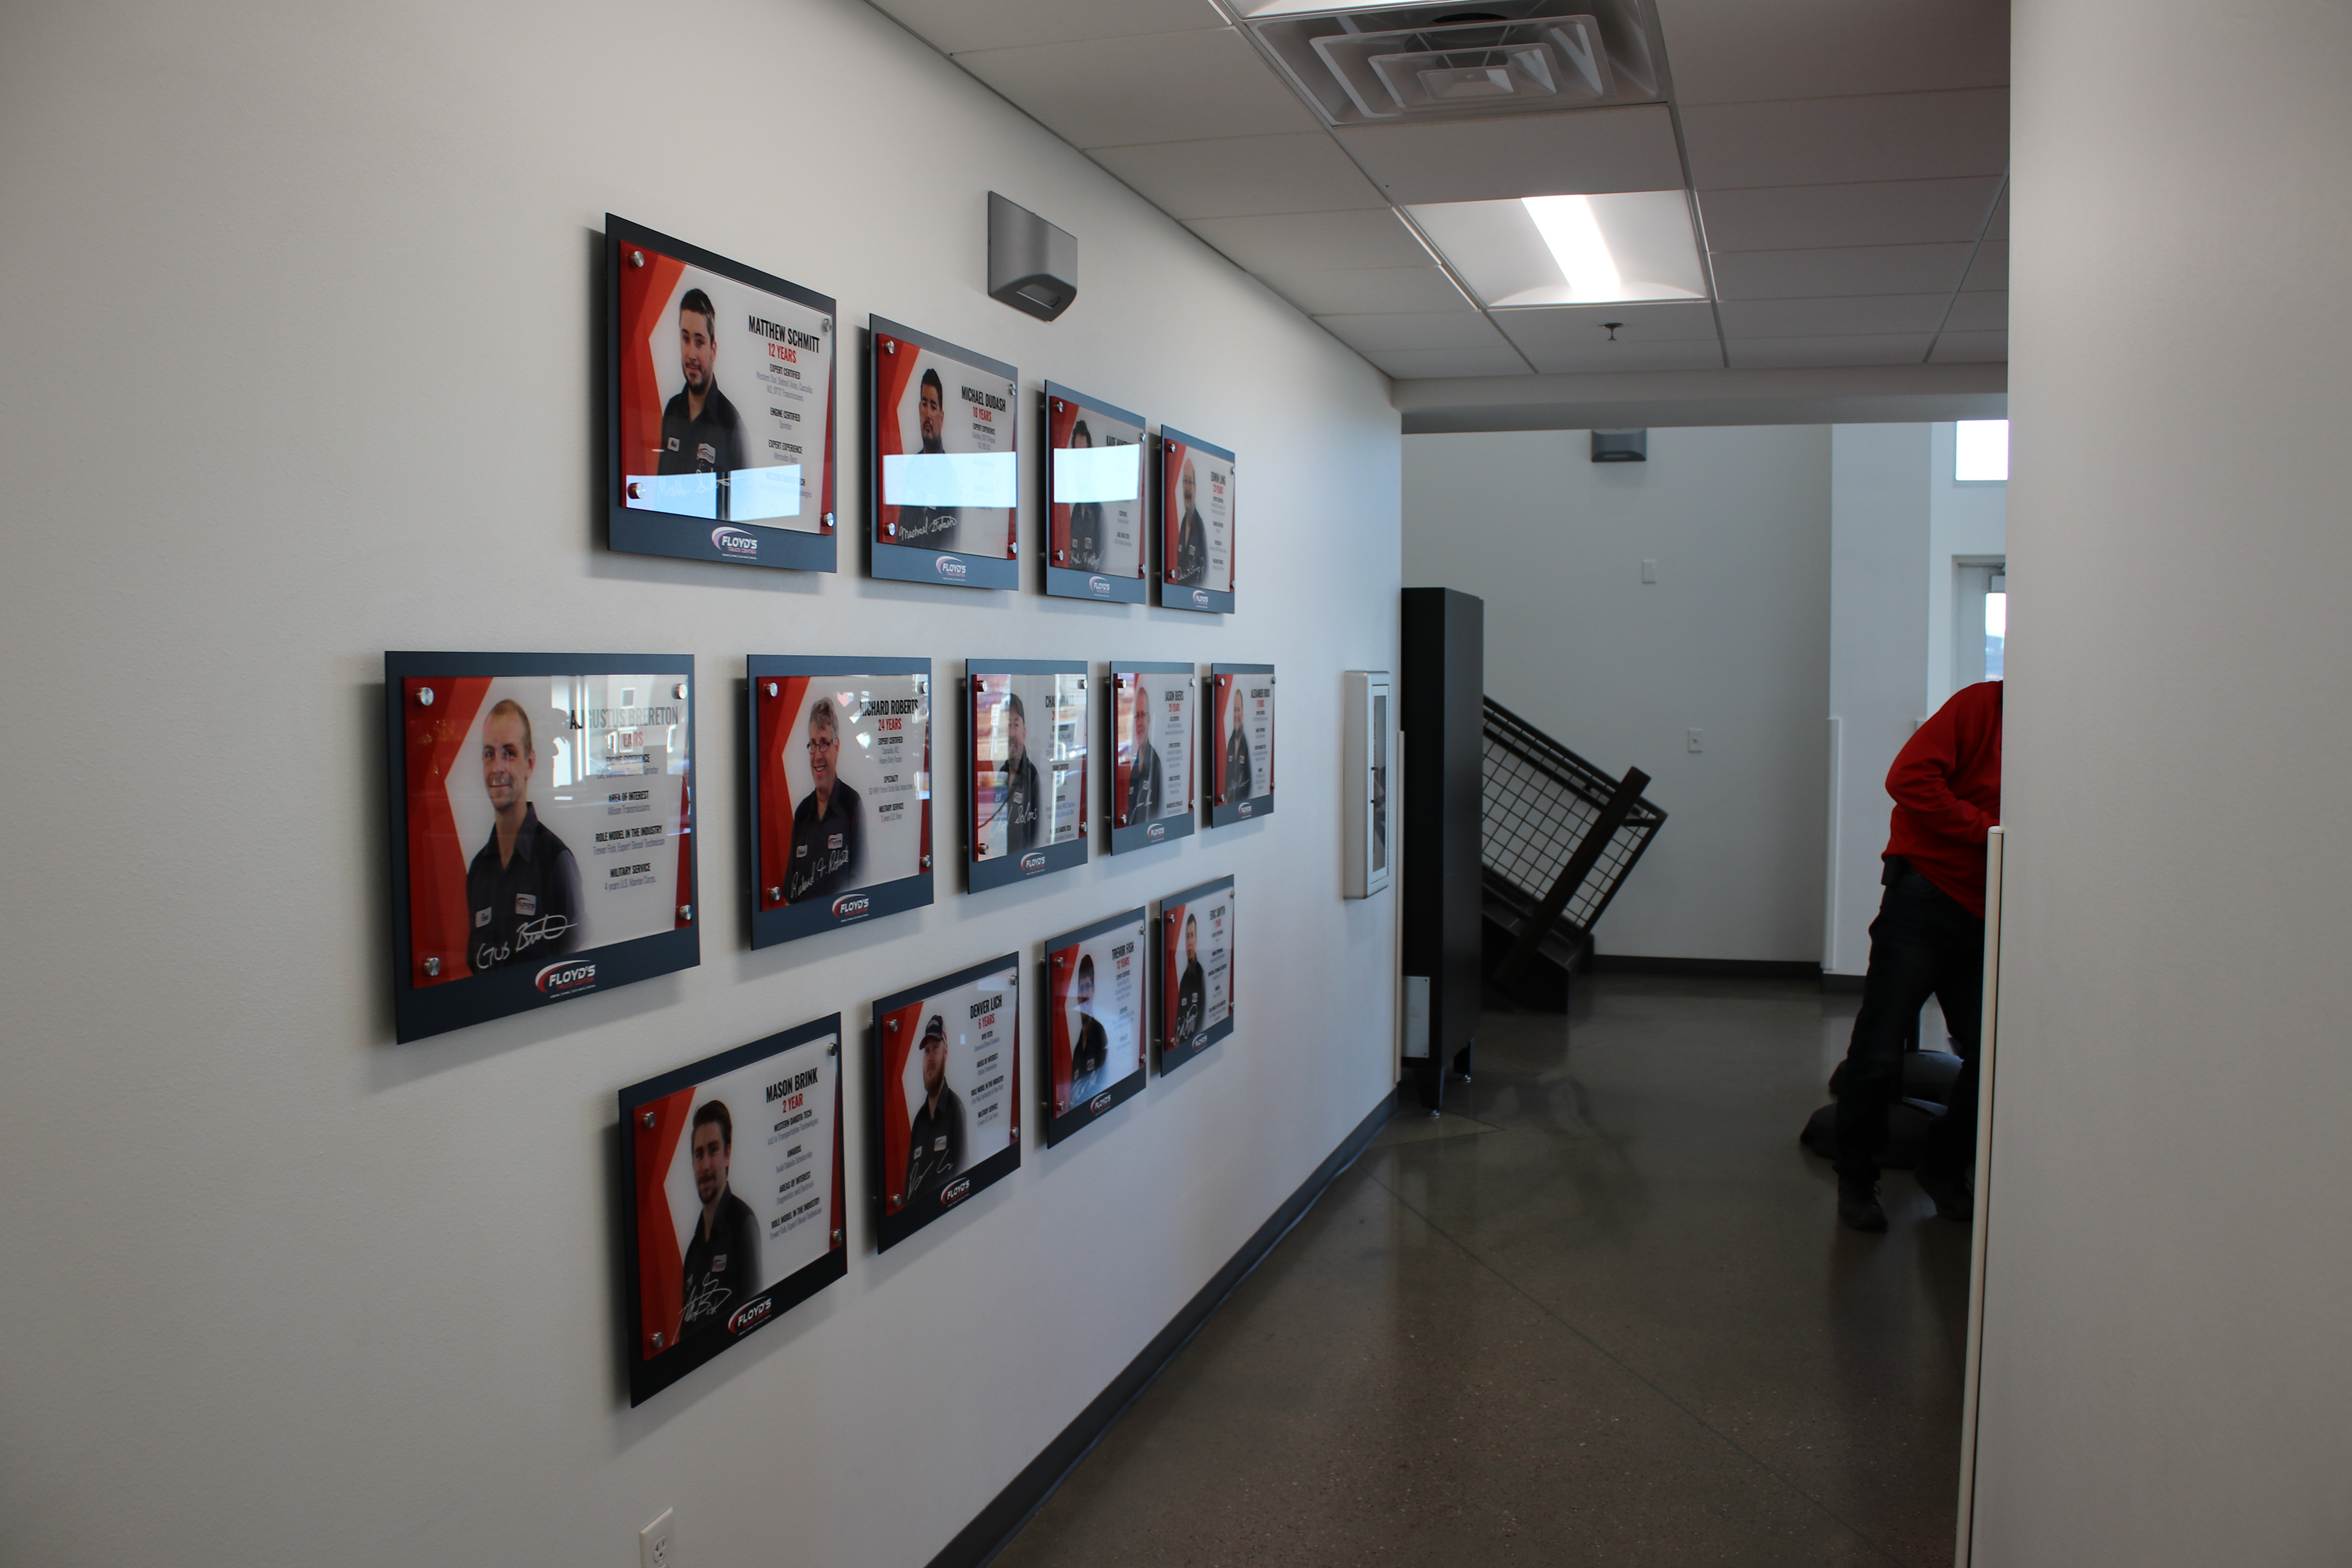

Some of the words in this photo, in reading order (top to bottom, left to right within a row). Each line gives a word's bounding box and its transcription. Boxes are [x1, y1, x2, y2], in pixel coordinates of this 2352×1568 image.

[748, 314, 786, 342] MATTHEW
[788, 328, 820, 353] SCHMITT
[768, 342, 775, 357] 12
[777, 345, 796, 363] YEARS
[769, 363, 783, 375] EXPERT
[783, 368, 801, 380] CERTIFIED
[962, 385, 984, 405] MICHAEL
[986, 393, 1006, 412] DUDASH
[783, 411, 801, 422] CERTIFIED
[978, 408, 992, 422] YEARS
[722, 535, 758, 549] FLOYD'S
[943, 563, 966, 573] FLOYD'S
[1094, 582, 1110, 590] FLOYD'S
[628, 706, 678, 726] BRERETON
[860, 700, 889, 717] RICHARD
[891, 699, 919, 715] ROBERTS
[878, 719, 885, 731] 24
[886, 718, 902, 731] YEARS
[620, 731, 643, 748] EARS
[609, 794, 620, 803] AREA
[621, 793, 628, 801] OF
[628, 790, 649, 801] INTEREST
[622, 804, 650, 814] Transmissions
[595, 832, 608, 842] ROLE
[609, 830, 624, 840] MODEL
[625, 829, 630, 838] IN
[641, 825, 662, 836] INDUSTRY
[1151, 827, 1164, 837] FLOYD'S
[644, 839, 665, 848] Technician
[610, 866, 631, 878] MILITARY
[632, 863, 651, 875] SERVICE
[1026, 856, 1046, 868] FLOYD'S
[840, 898, 869, 913] FLOYD'S
[549, 965, 596, 987] FLOYD'S
[970, 999, 990, 1019] DENVER
[990, 994, 1002, 1011] LICH
[982, 1013, 995, 1028] YEARS
[766, 1077, 793, 1103] MASON
[795, 1067, 818, 1092] BRINK
[783, 1100, 787, 1114] 2
[788, 1093, 803, 1110] YEAR
[1095, 1095, 1111, 1110] FLOYD'S
[774, 1119, 789, 1133] WESTERN
[790, 1112, 803, 1125] DAKOTA
[804, 1109, 812, 1119] TECH
[787, 1145, 802, 1158] AWARDS
[779, 1181, 790, 1193] AREAS
[791, 1178, 795, 1188] OF
[796, 1170, 811, 1185] INTEREST
[947, 1180, 970, 1200] FLOYD'S
[771, 1218, 780, 1229] ROLE
[781, 1212, 793, 1224] MODEL
[793, 1209, 797, 1218] IN
[804, 1196, 820, 1212] INDUSTRY
[737, 1297, 772, 1327] FLOYD'S
